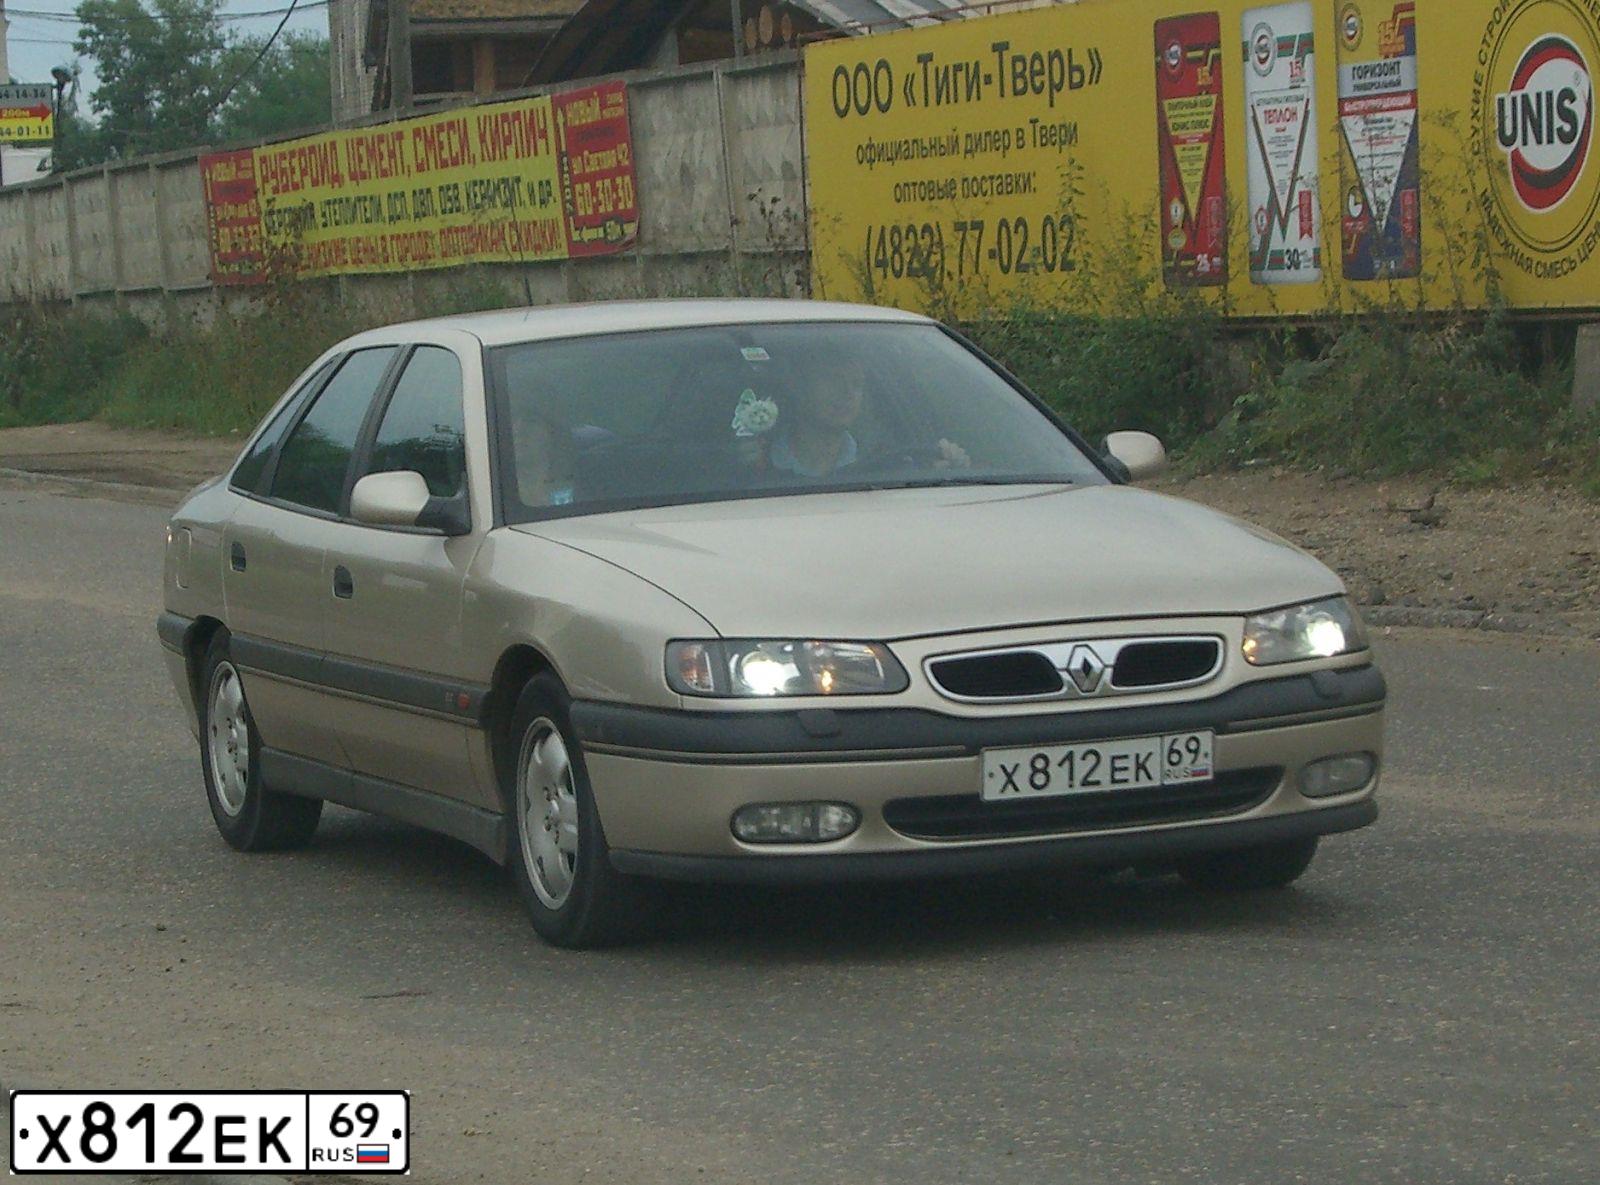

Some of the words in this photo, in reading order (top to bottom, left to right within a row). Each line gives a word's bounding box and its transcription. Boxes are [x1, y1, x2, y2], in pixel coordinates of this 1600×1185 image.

[832, 58, 893, 118] ООО
[903, 41, 1103, 107] «Тиги-Тверь»
[346, 130, 411, 184] ЦЕМЕНТ,
[412, 117, 476, 168] СМЕСИ,
[477, 106, 550, 161] КИРПИЧ
[856, 126, 960, 167] официальный
[964, 127, 1011, 159] дилер
[1016, 127, 1026, 150] в
[1029, 117, 1078, 153] Твери
[1497, 86, 1579, 147] UNIS
[893, 181, 957, 203] оптовые
[961, 171, 1036, 199] поставки:
[1534, 256, 1577, 278] СМЕСЬ
[1000, 748, 1153, 793] Х812ЕК
[1166, 735, 1201, 767] 69
